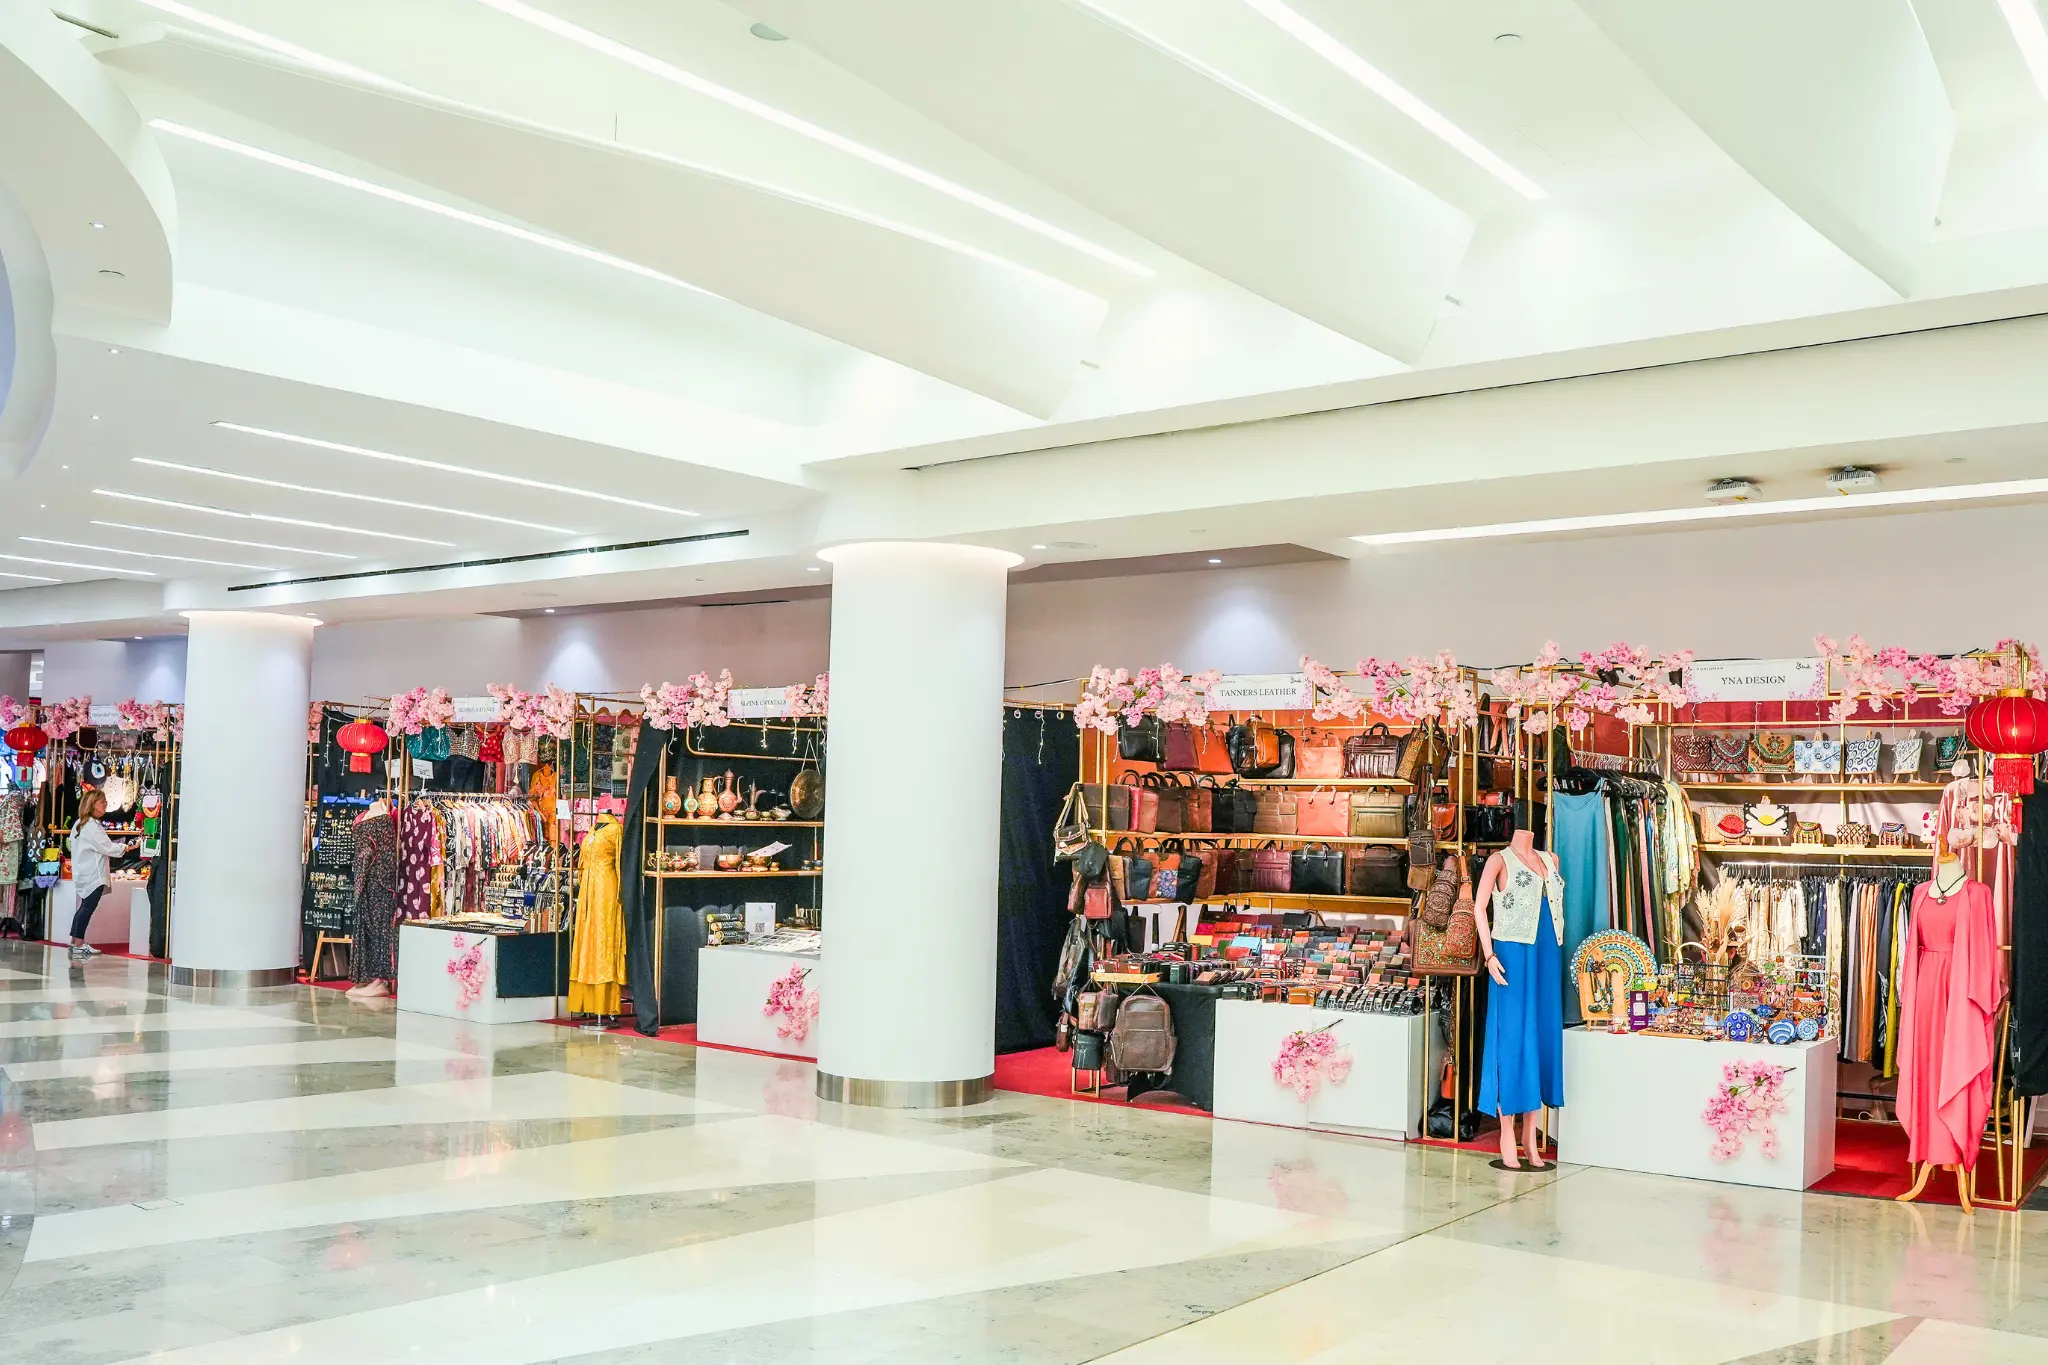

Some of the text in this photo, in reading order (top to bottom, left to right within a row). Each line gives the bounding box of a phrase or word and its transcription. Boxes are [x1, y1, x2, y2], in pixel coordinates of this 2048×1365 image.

[1721, 675, 1786, 685] YNA DESIGN
[1220, 688, 1297, 697] TANNERS LEATHER
